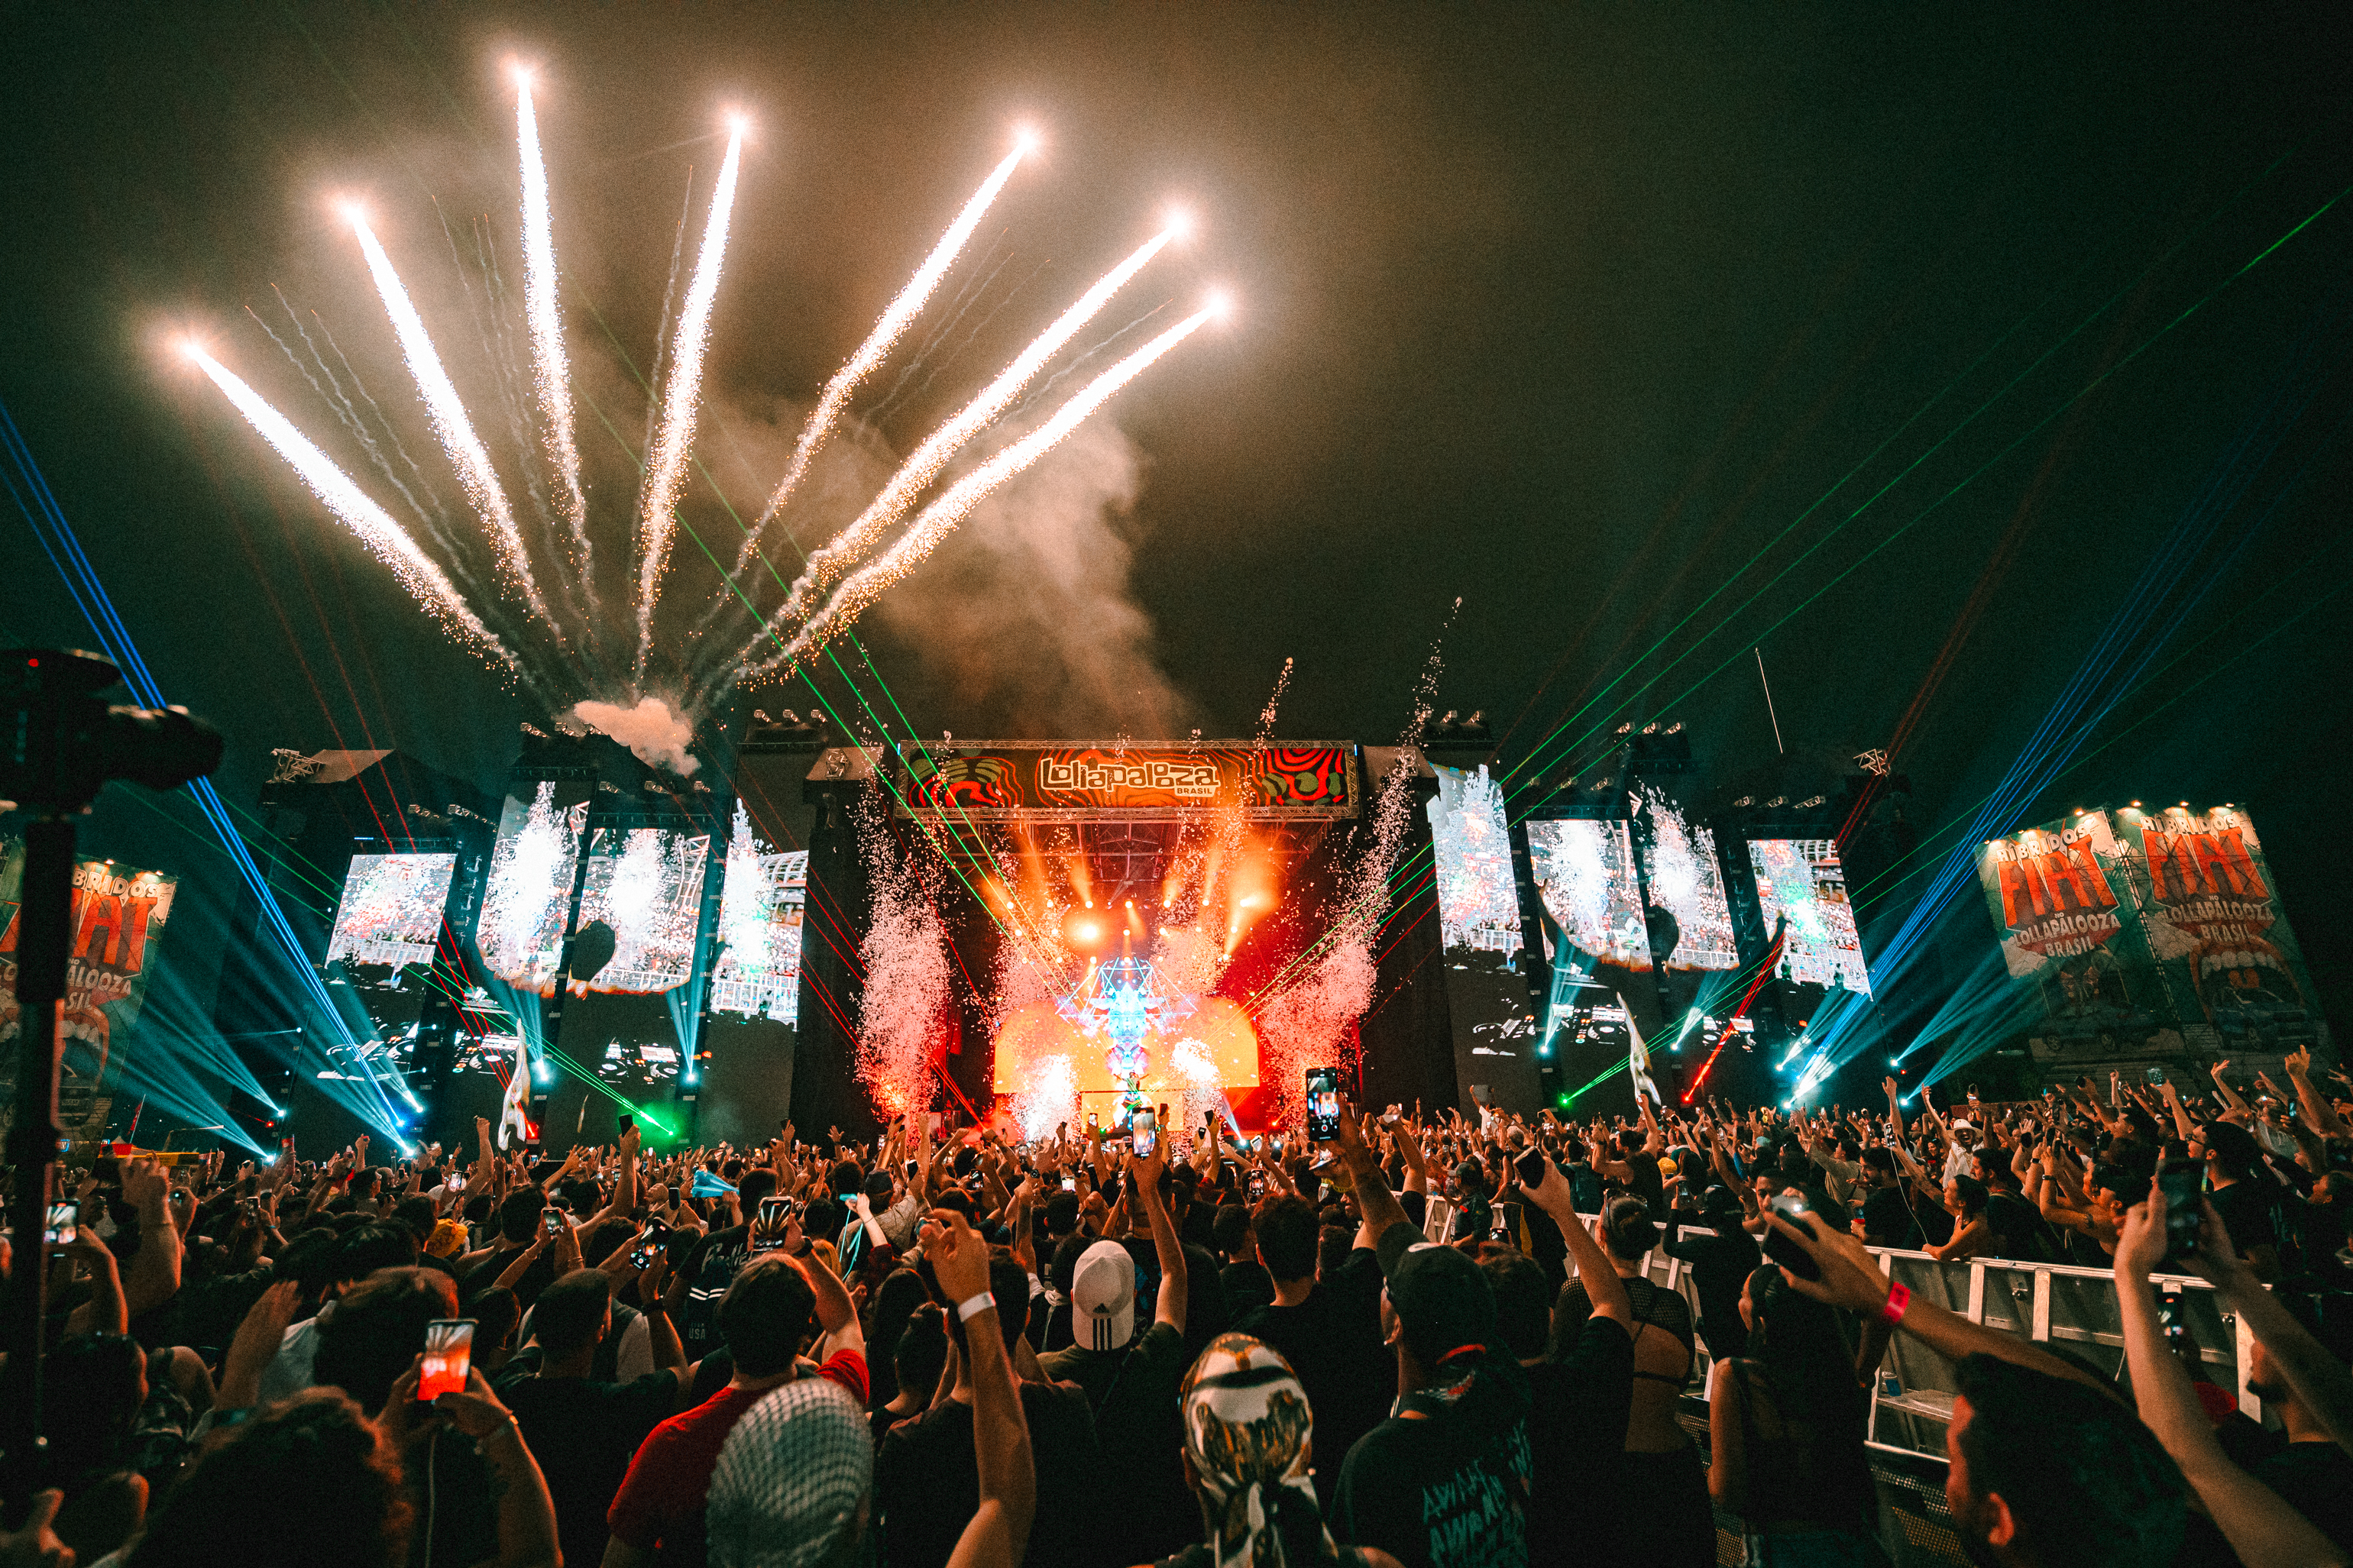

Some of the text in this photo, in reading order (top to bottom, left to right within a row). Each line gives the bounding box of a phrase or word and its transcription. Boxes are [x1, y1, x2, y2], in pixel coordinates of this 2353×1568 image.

[2143, 826, 2270, 900] FIAT
[72, 868, 158, 897] BRIDOS
[1998, 834, 2117, 927] FIAT
[2164, 900, 2275, 923] LOLLAPALOOZA
[2014, 913, 2122, 947] LOLLAPALOOZA
[2200, 924, 2255, 943] BRASIL
[2046, 936, 2095, 958] BRASIL
[688, 1328, 705, 1340] USA
